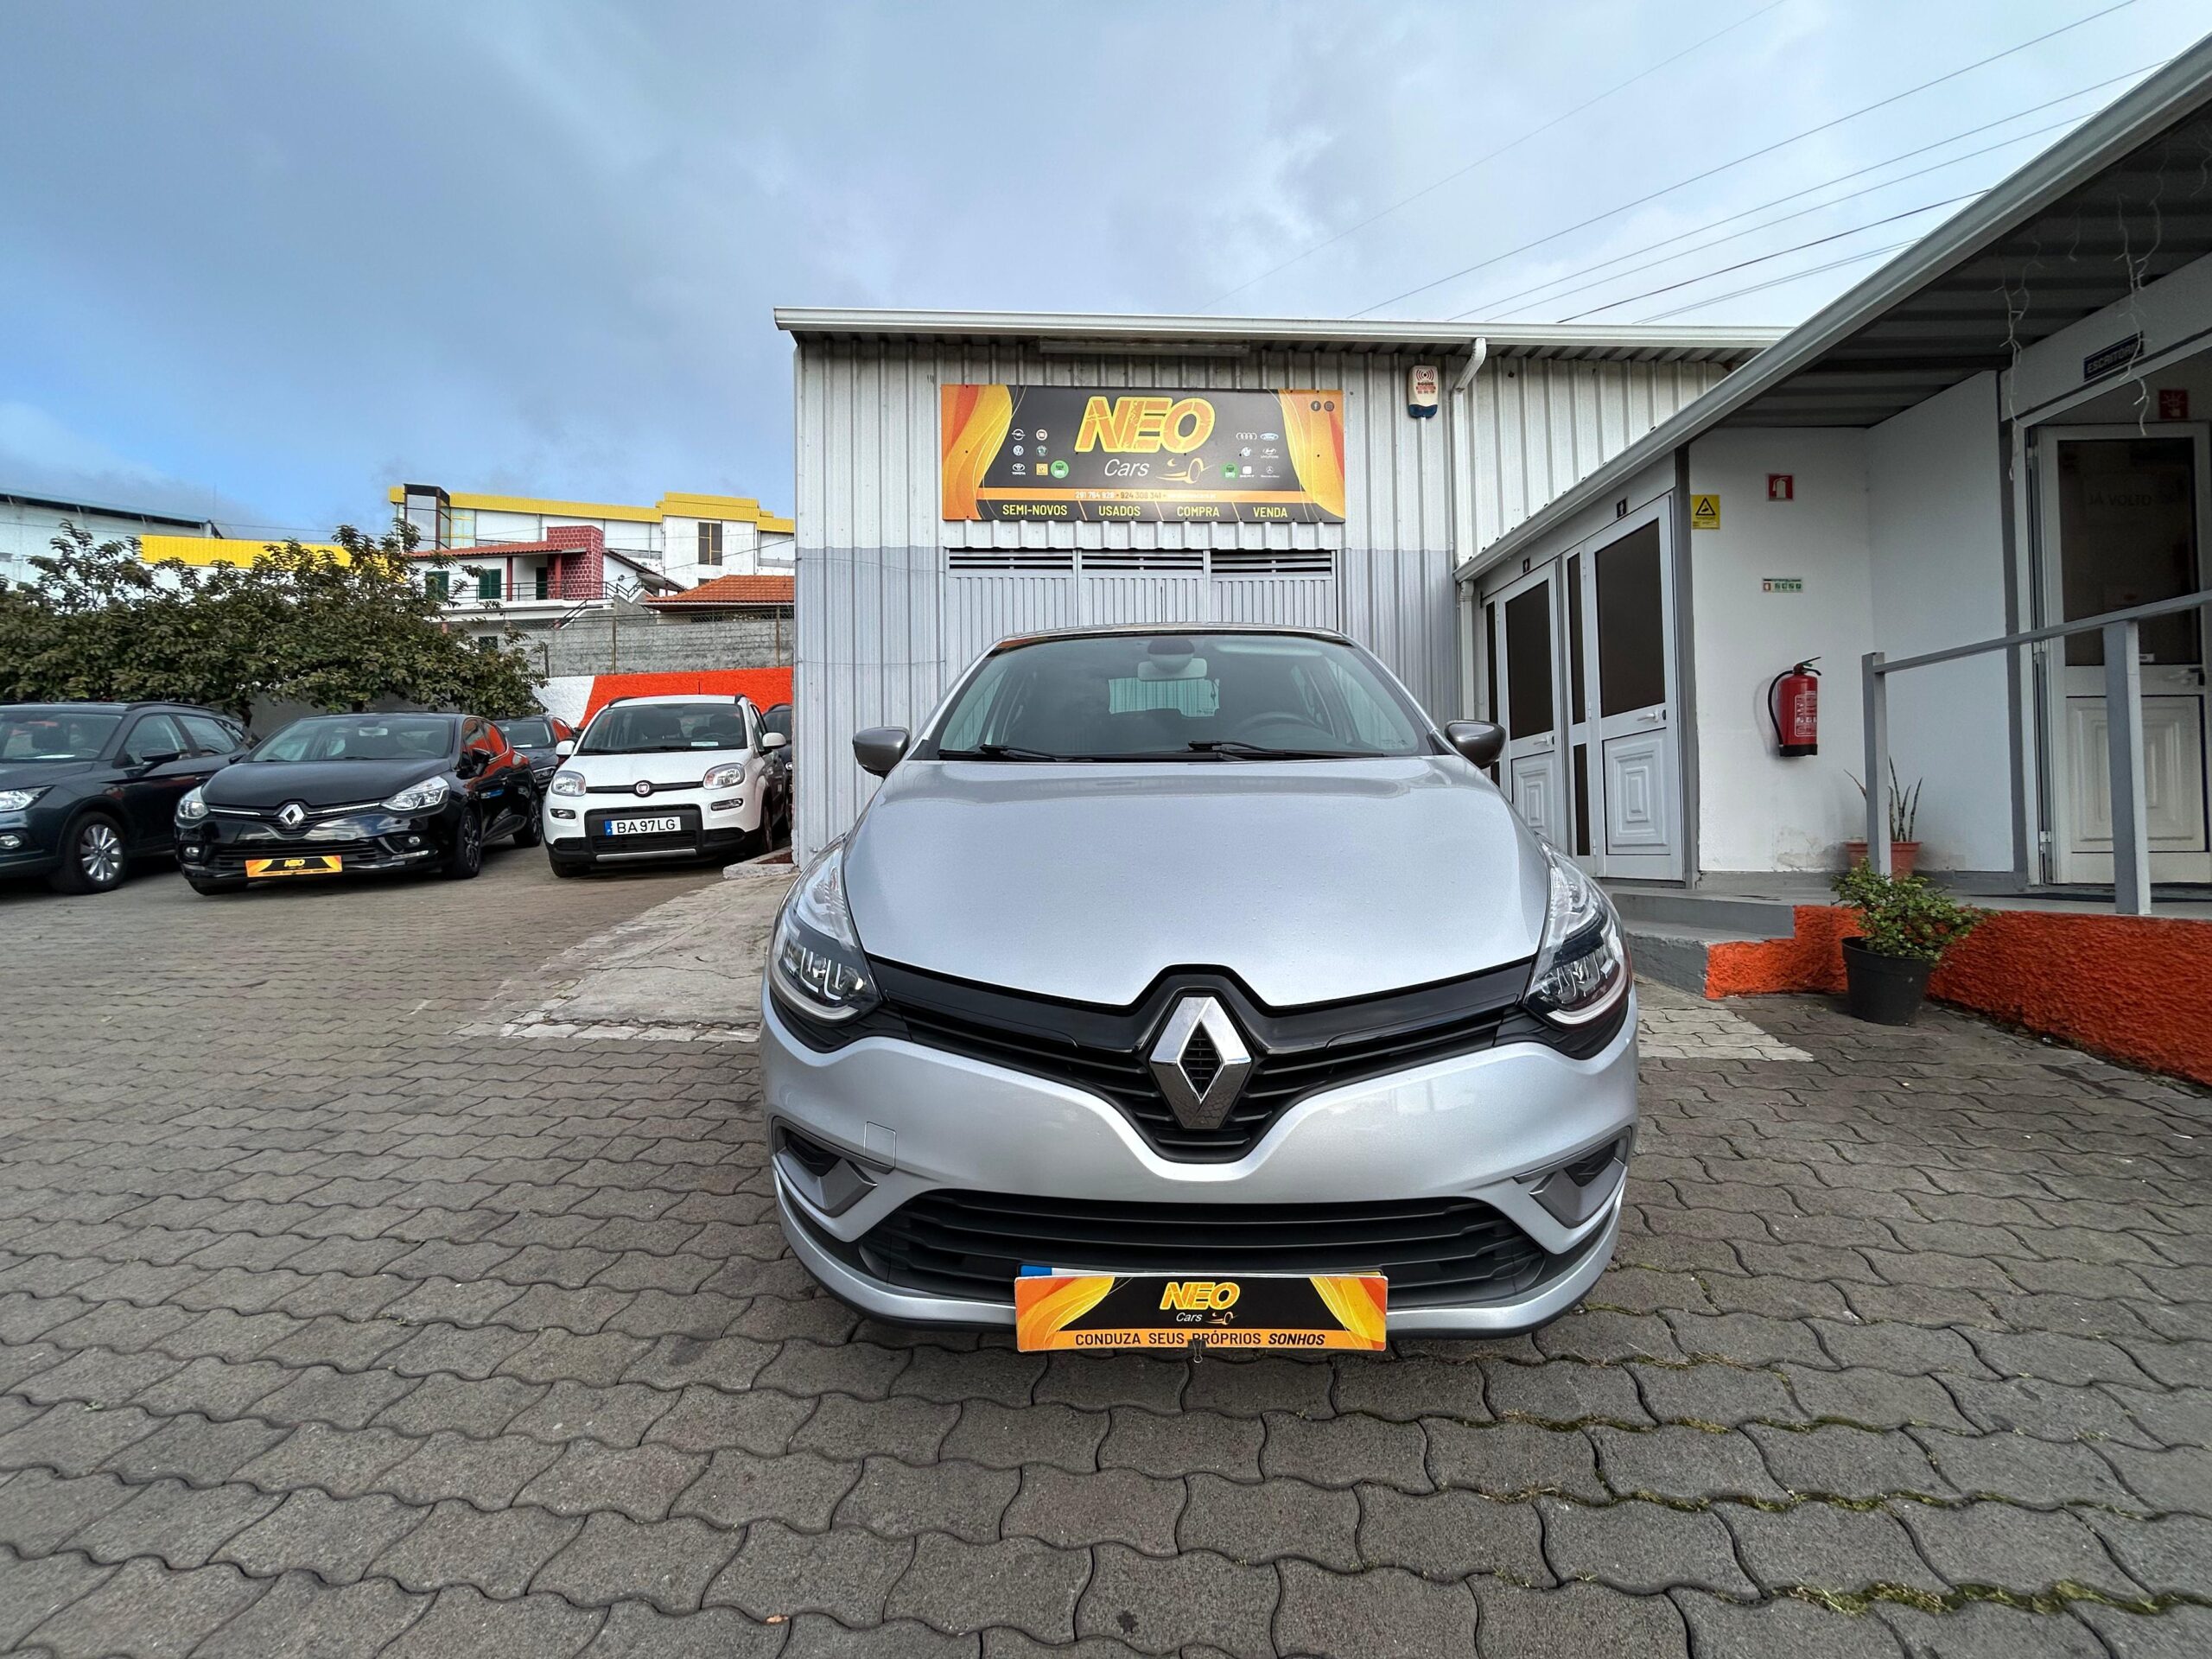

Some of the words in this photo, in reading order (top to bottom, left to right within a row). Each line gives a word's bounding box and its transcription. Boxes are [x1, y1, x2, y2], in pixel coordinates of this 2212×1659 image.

[1074, 396, 1216, 454] NEO
[1104, 459, 1150, 476] Cars
[1002, 504, 1068, 516] SEMI-NOVOS
[1098, 505, 1141, 517] USADOS
[1177, 505, 1220, 517] COMPRA
[1253, 506, 1288, 518] VENDA
[1159, 1281, 1241, 1311] NEO
[1176, 1312, 1203, 1322] Cars
[1075, 1332, 1141, 1345] CONDUZA
[1148, 1332, 1185, 1344] SEUS
[1192, 1330, 1262, 1344] PRÓPRIOS
[1268, 1332, 1325, 1345] SONHOS
